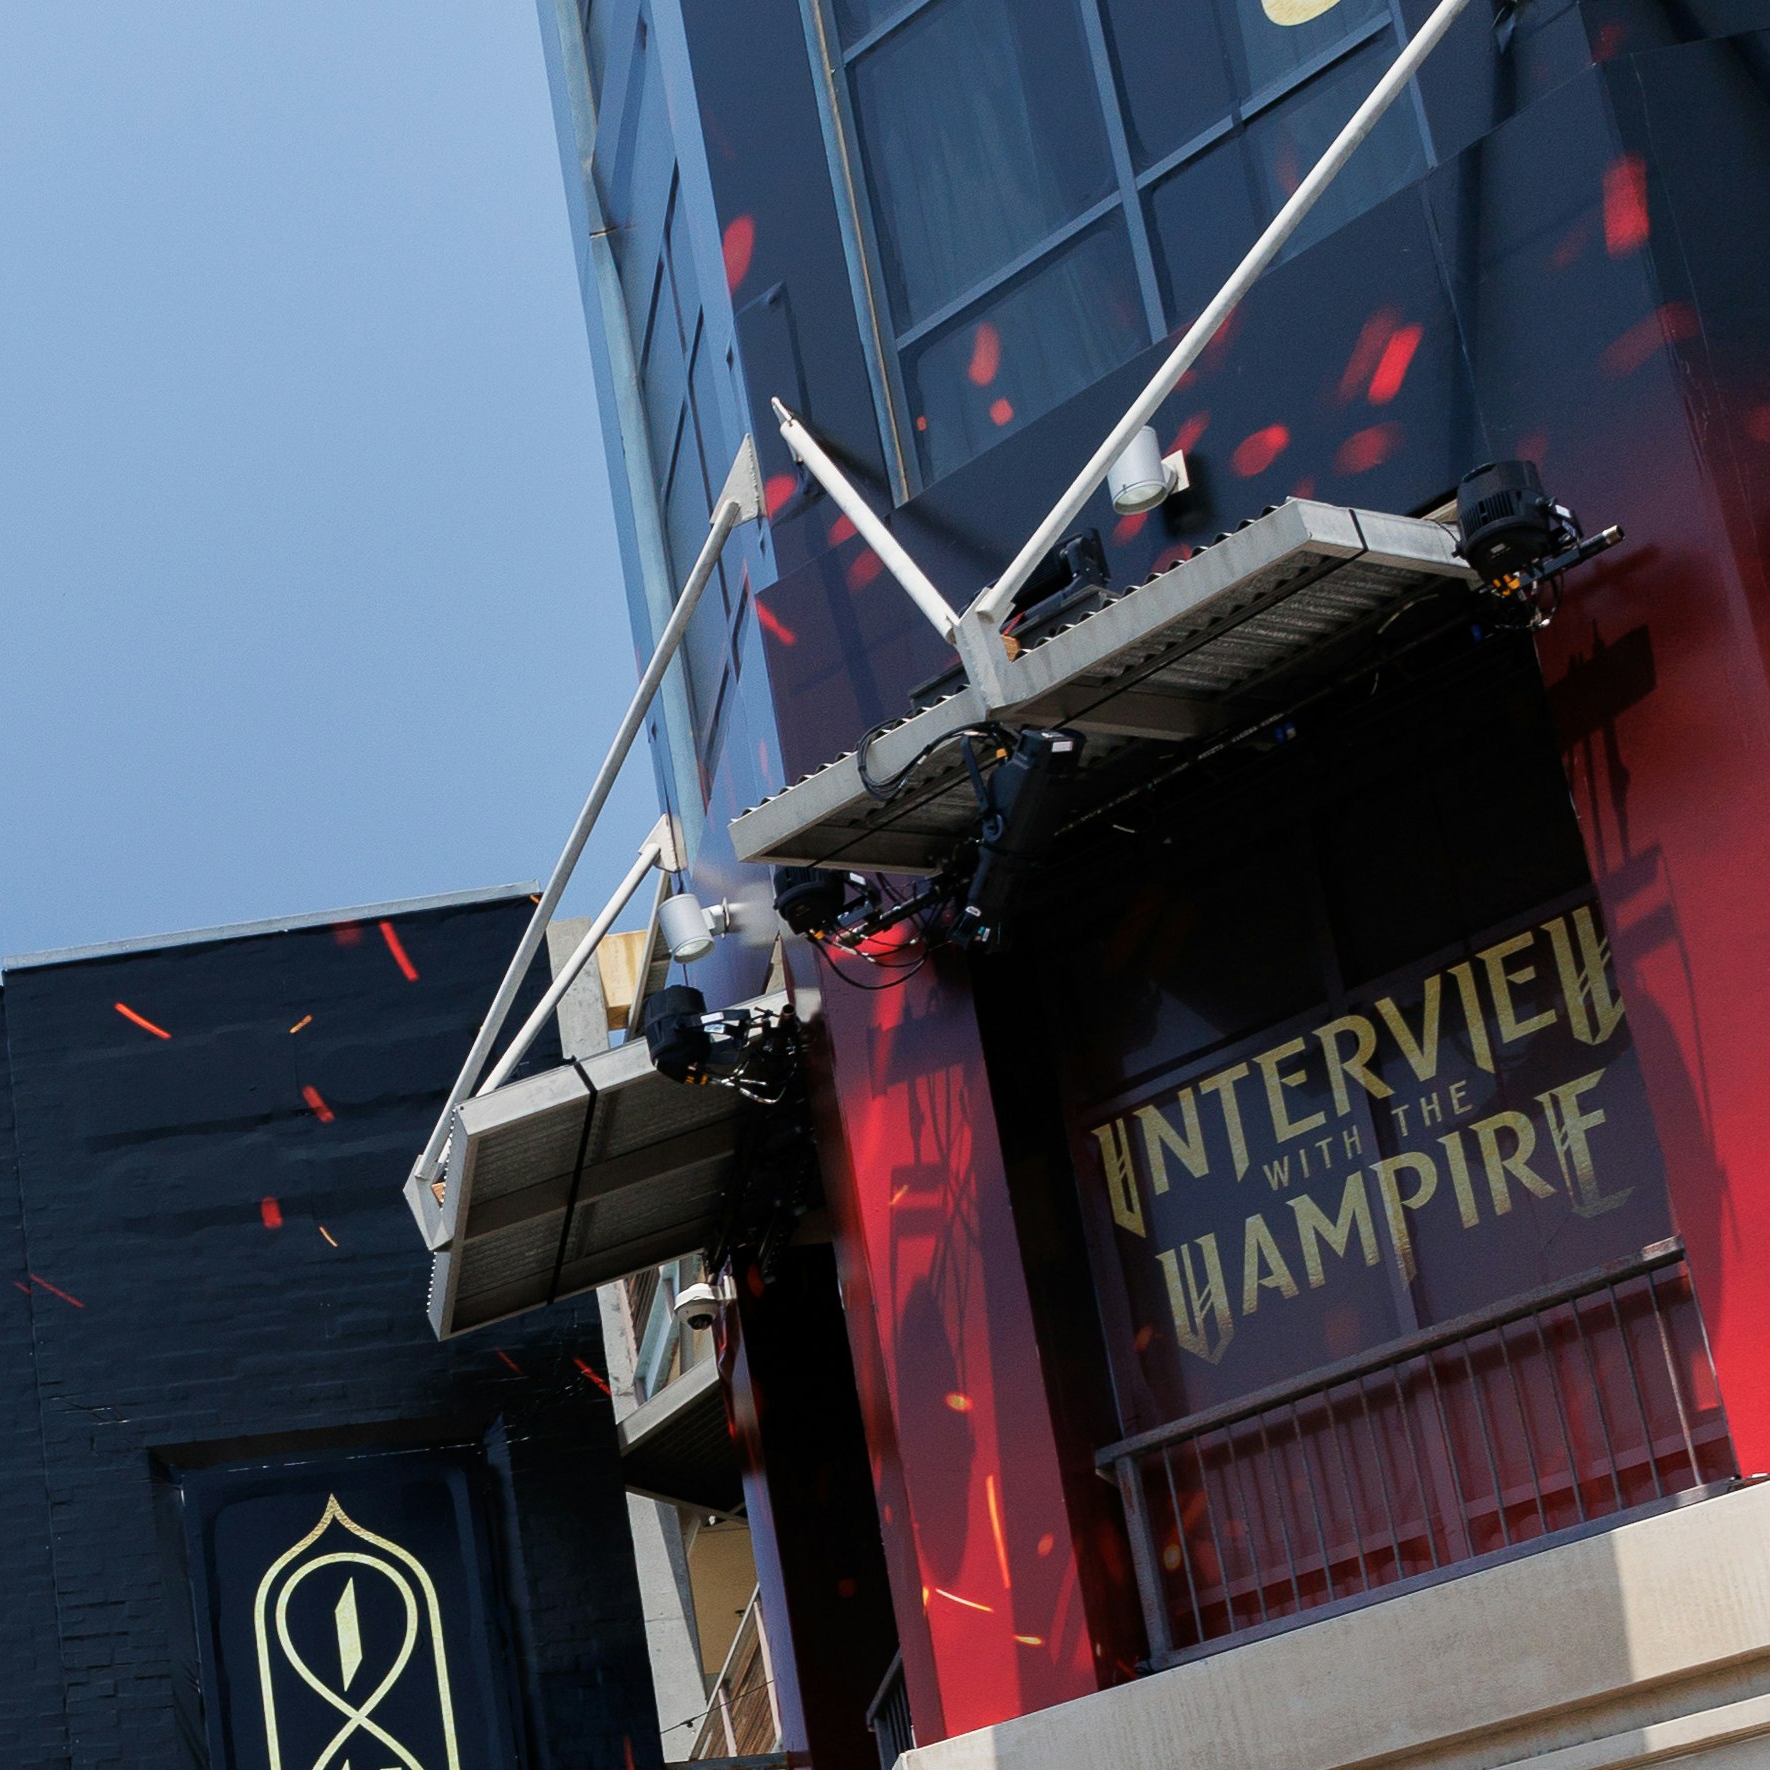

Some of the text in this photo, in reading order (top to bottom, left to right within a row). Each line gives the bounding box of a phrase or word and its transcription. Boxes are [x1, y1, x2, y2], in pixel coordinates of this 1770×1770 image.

[1155, 1067, 1635, 1366] VAMPIRE
[1261, 1079, 1473, 1191] WITH THE
